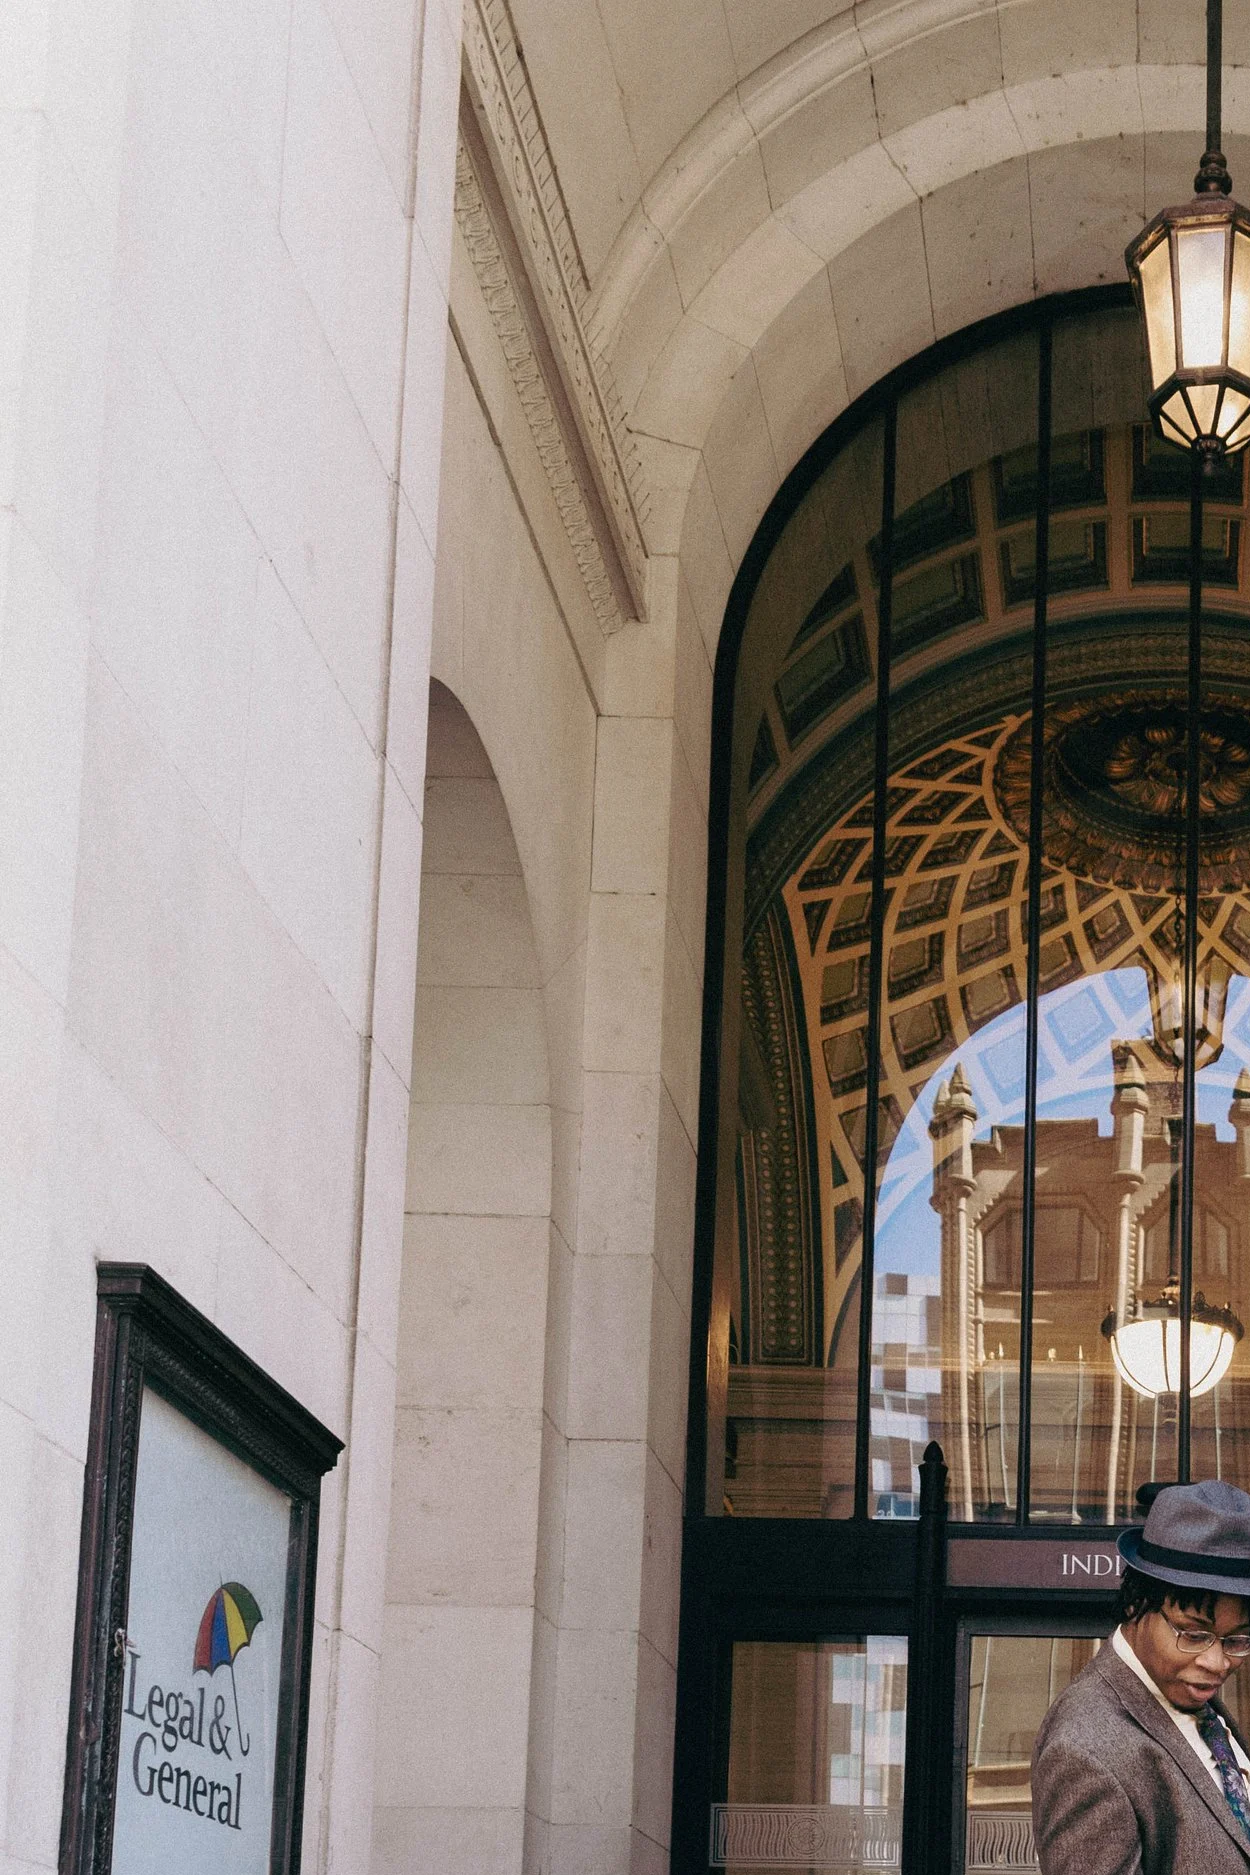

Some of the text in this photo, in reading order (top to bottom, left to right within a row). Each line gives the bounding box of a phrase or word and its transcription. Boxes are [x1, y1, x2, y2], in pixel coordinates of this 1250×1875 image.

[124, 1650, 232, 1761] Legal &
[132, 1731, 242, 1830] General
